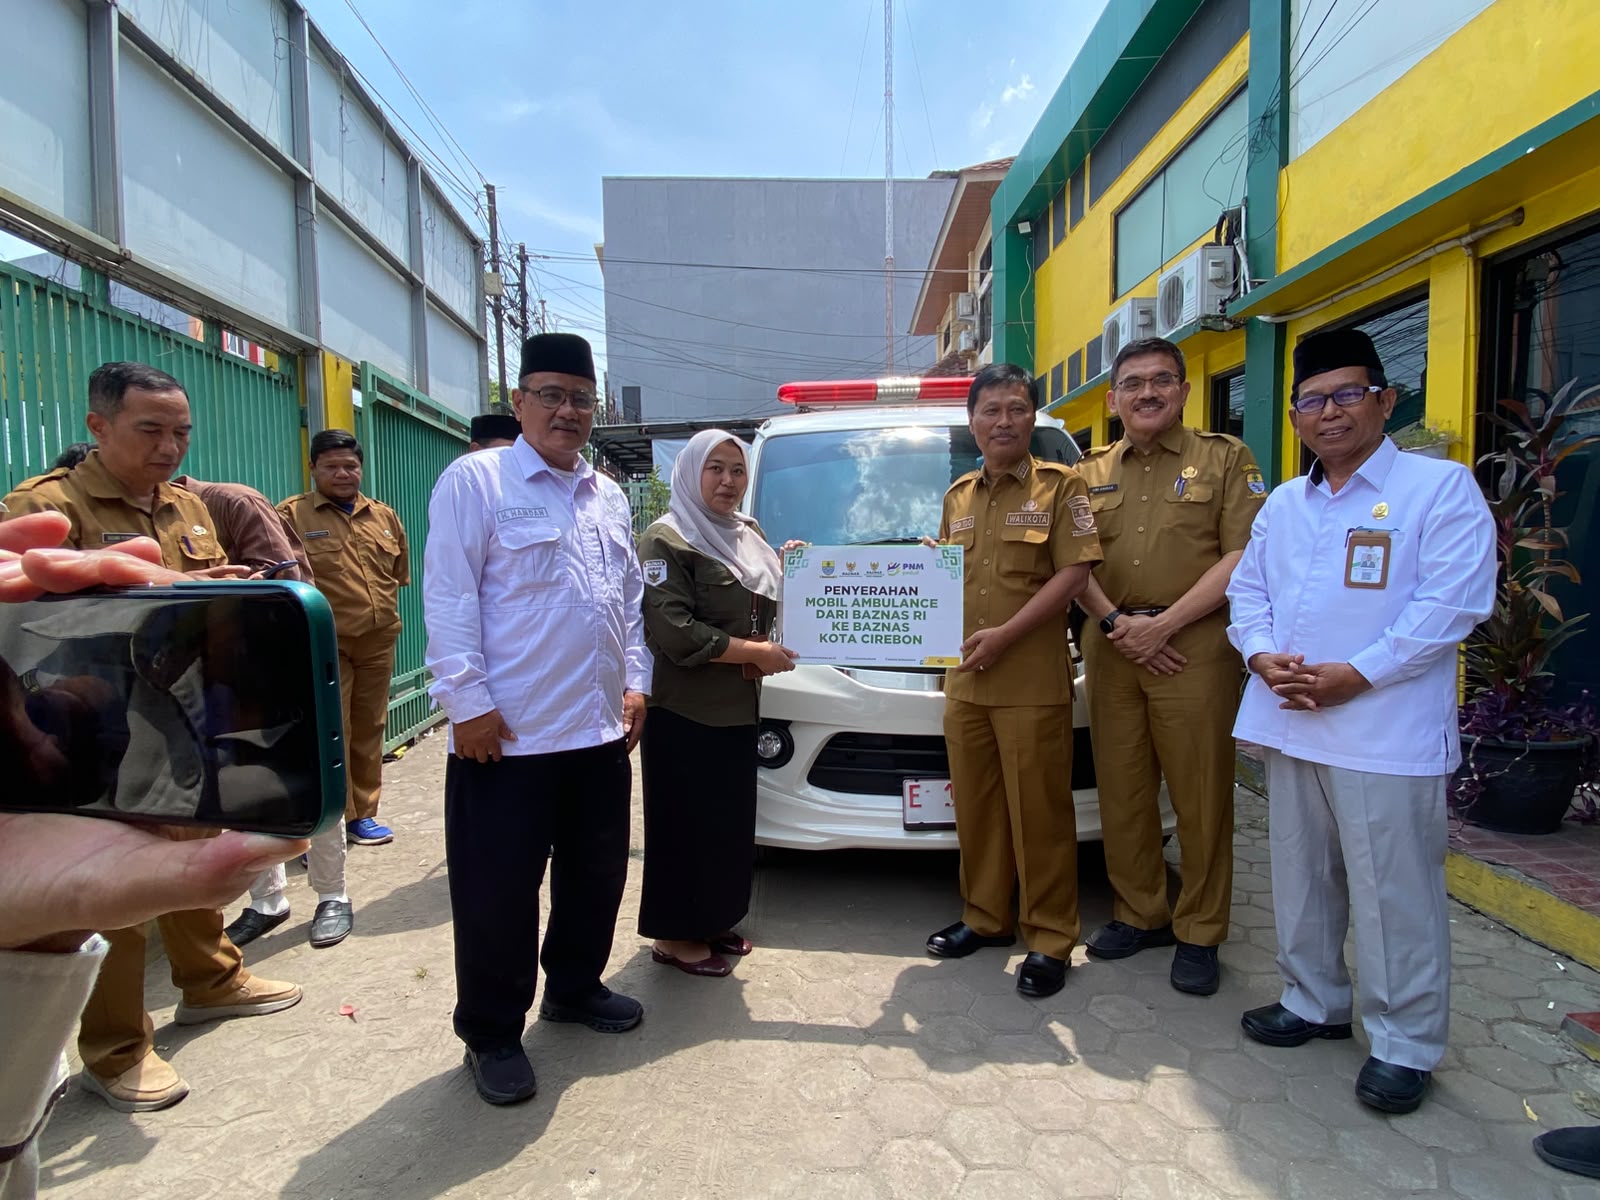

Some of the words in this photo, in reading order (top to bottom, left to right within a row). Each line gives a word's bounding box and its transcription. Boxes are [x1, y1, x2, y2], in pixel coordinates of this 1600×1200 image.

[1009, 514, 1047, 524] WALIKOTA
[824, 585, 919, 596] PENYERAHAN
[805, 597, 848, 608] MOBIL
[851, 598, 938, 609] AMBULANCE
[816, 609, 848, 619] DARI
[852, 610, 909, 620] BAZNAS
[913, 610, 926, 620] RI
[831, 621, 849, 631] KE
[853, 622, 910, 632] BAZNAS
[819, 633, 857, 644] KOTA
[861, 634, 923, 645] CIREBON
[909, 784, 922, 808] E
